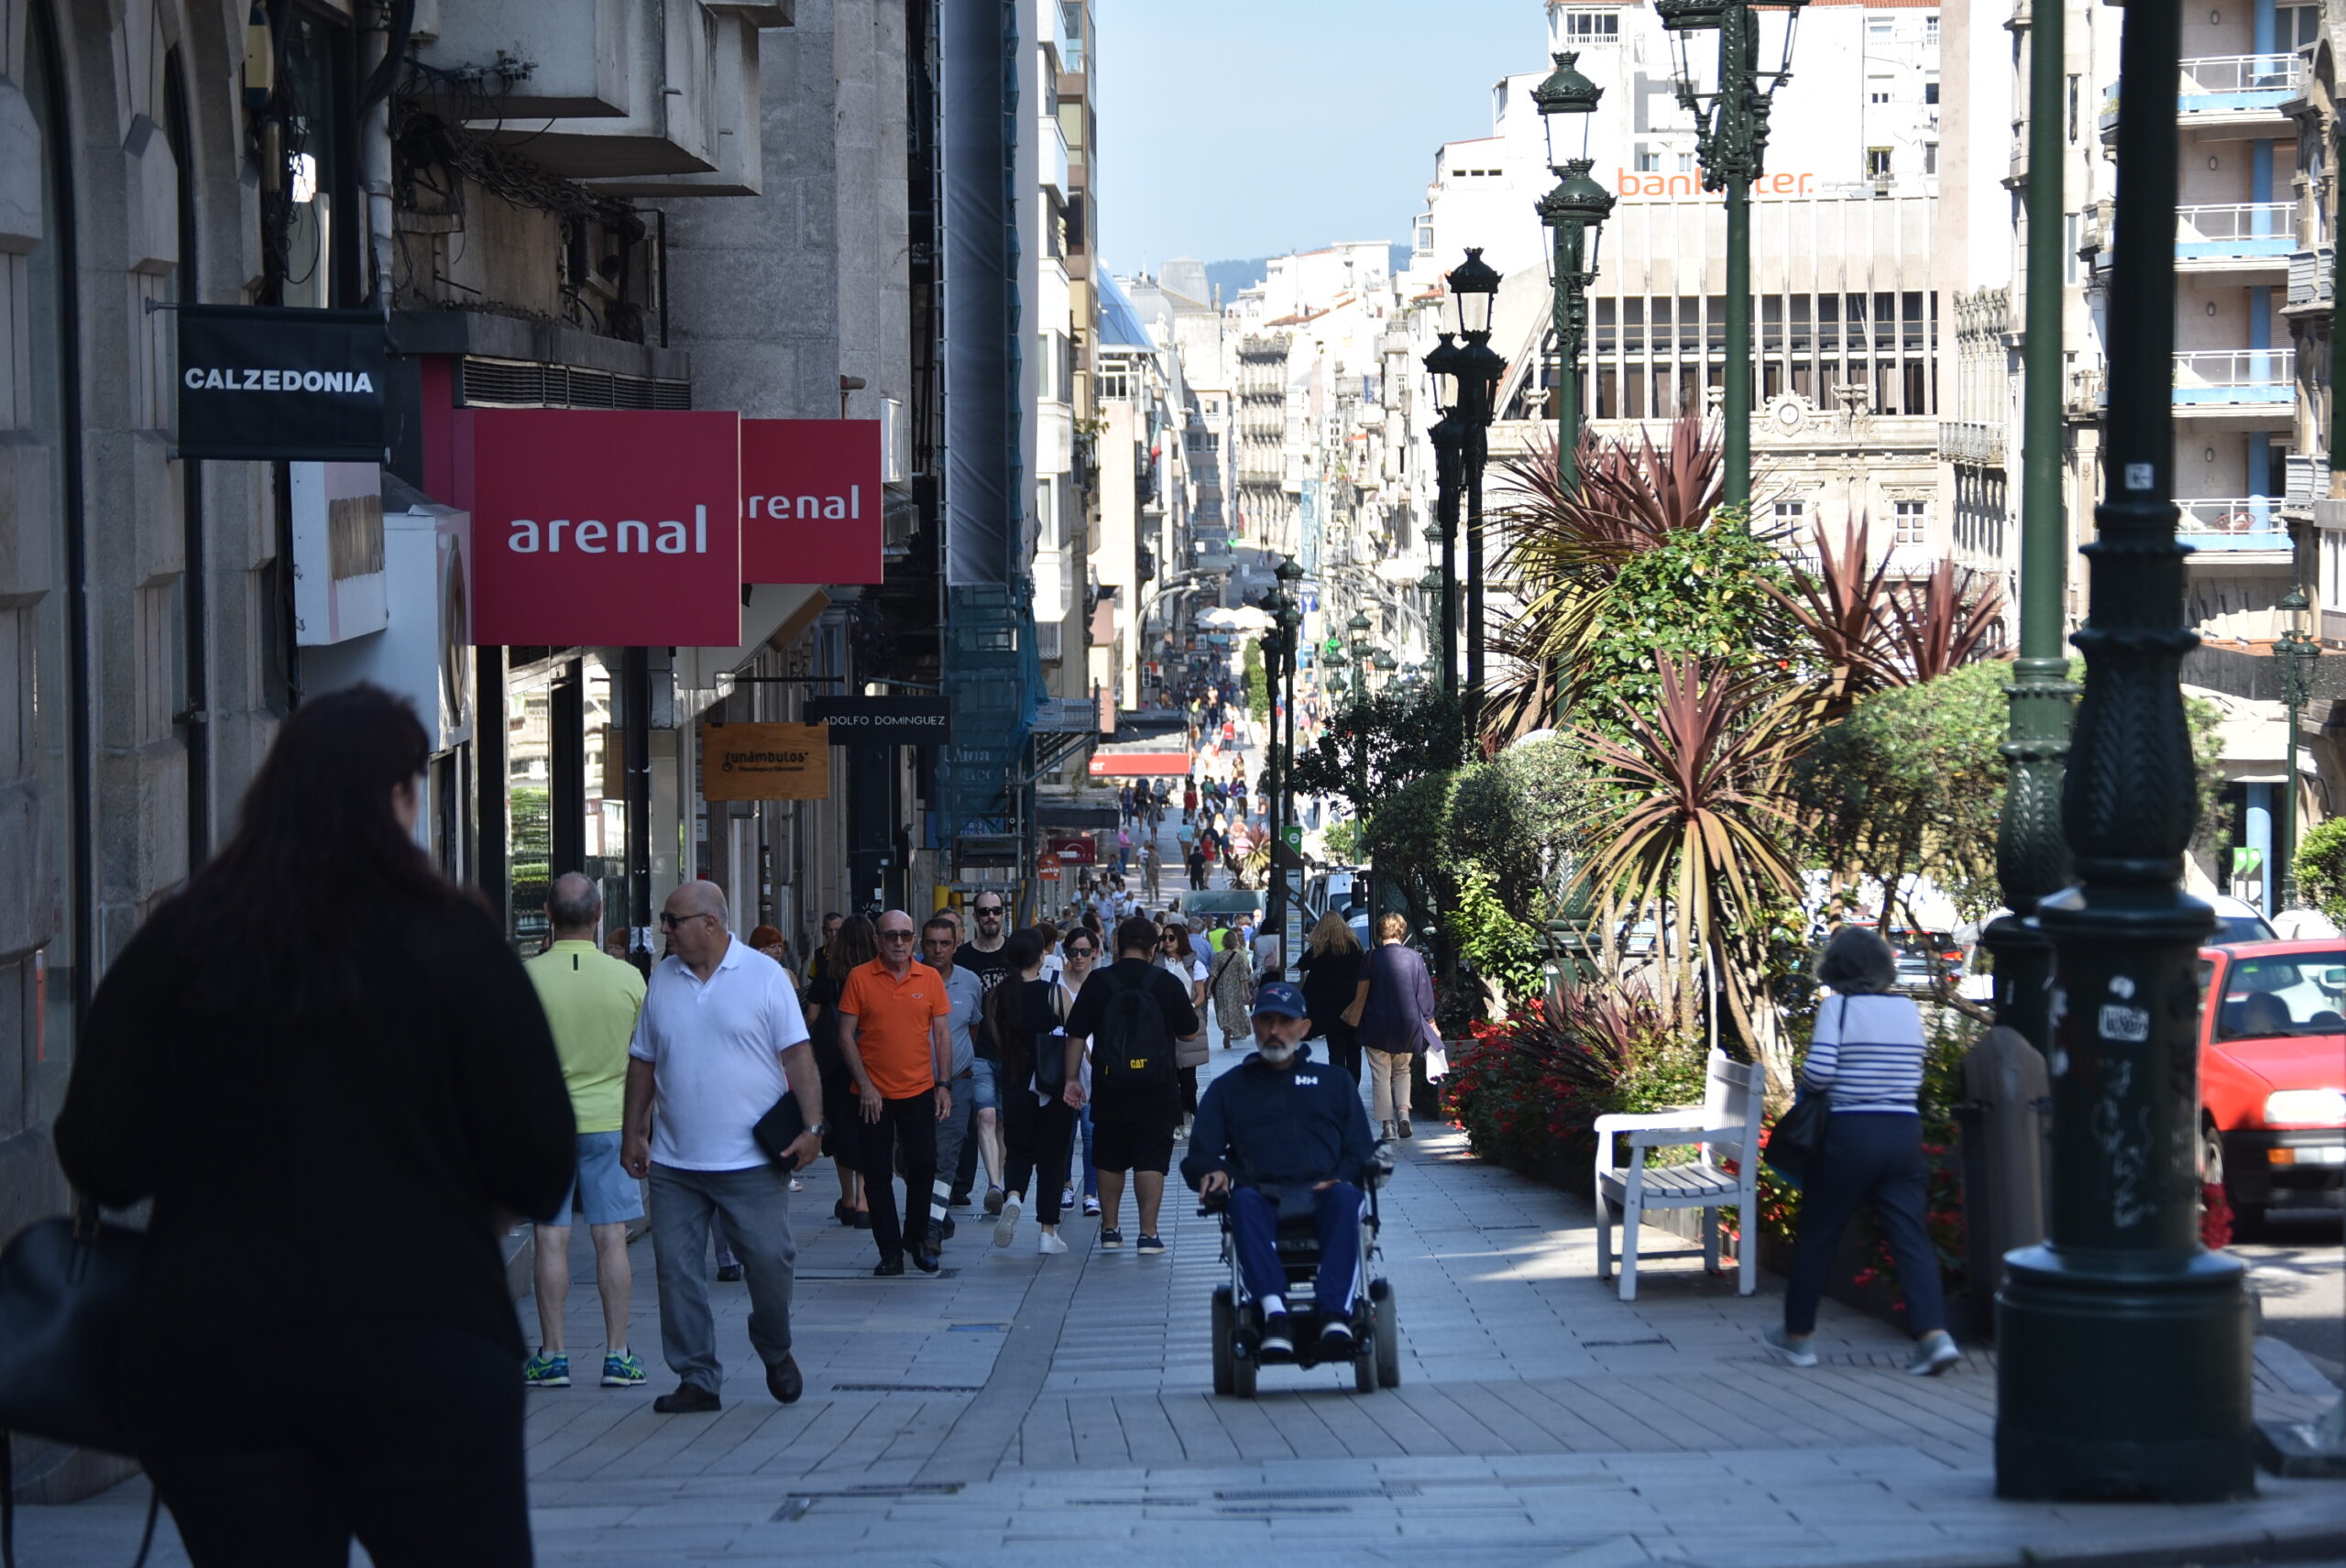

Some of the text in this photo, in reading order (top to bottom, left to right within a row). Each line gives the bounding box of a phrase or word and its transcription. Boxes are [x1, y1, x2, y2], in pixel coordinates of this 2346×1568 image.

[185, 367, 374, 394] CALZEDONIA
[740, 484, 860, 520] renal
[509, 504, 707, 554] arenal
[822, 716, 945, 726] ADOLFO DOMINGUEZ
[1130, 1058, 1145, 1069] CAT
